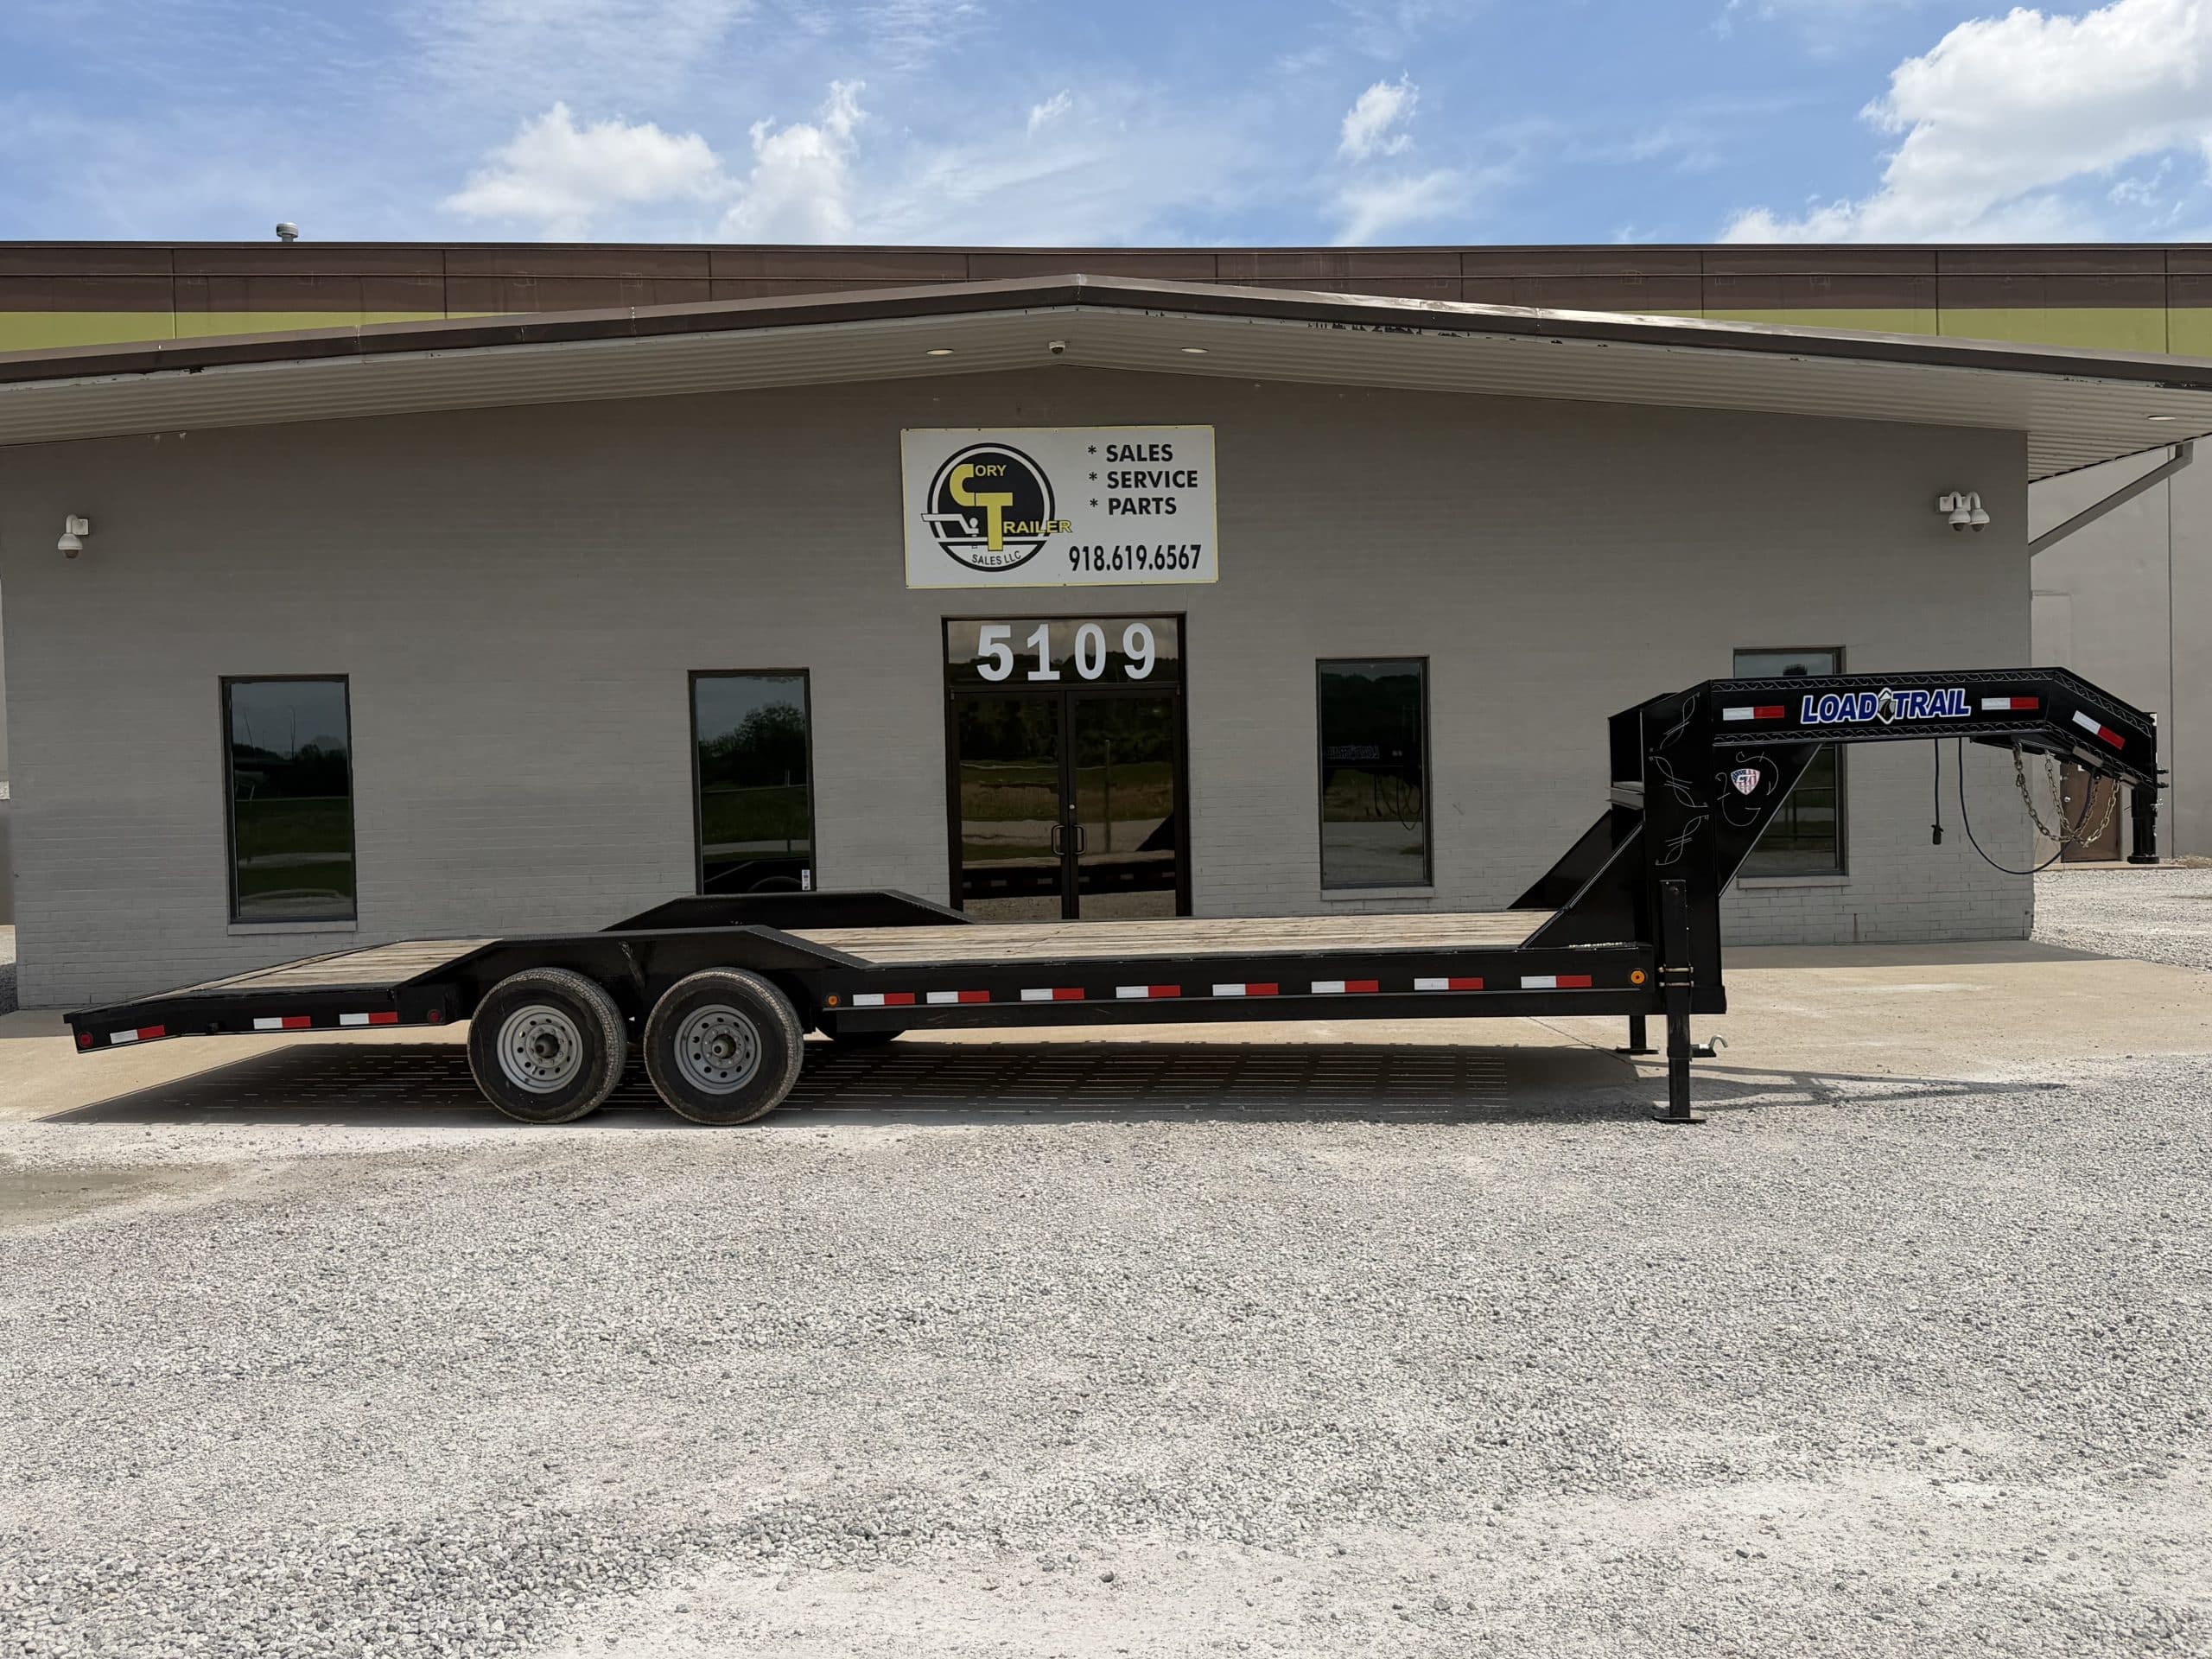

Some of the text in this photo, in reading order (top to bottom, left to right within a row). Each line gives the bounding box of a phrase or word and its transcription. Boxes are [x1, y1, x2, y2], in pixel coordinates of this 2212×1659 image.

[1106, 444, 1173, 462] SALES
[950, 463, 1007, 506] CORY
[1107, 470, 1198, 489] SERVICE
[1108, 497, 1177, 515] PARTS
[975, 493, 1072, 551] TRAILER
[972, 550, 1021, 565] SALES LLC
[1069, 544, 1201, 571] 918.619.6567
[976, 623, 1155, 681] 5109
[1801, 689, 1971, 724] LOAD TRAIL
